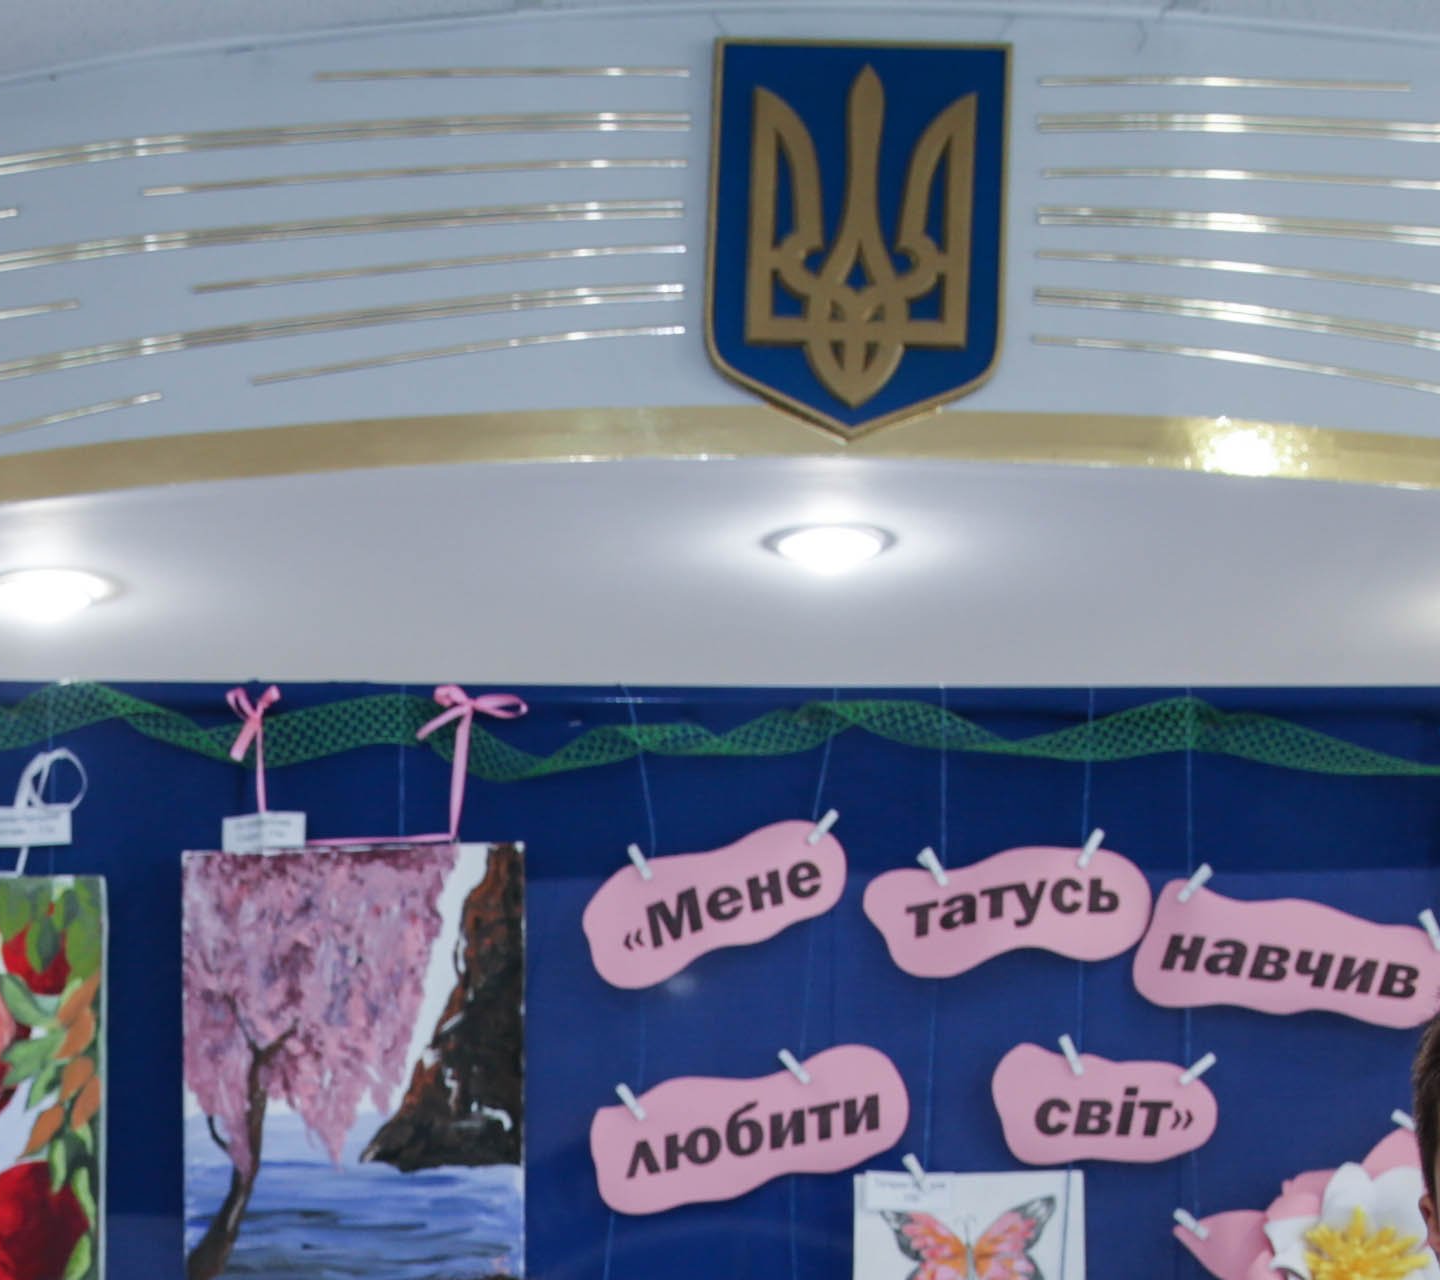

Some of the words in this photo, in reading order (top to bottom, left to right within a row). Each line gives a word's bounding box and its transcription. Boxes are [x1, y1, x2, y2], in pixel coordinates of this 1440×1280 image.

[623, 857, 823, 955] «Мене
[905, 874, 1121, 944] татусь
[1160, 928, 1421, 1002] навчив
[625, 1090, 882, 1181] любити
[1032, 1085, 1195, 1140] світ»
